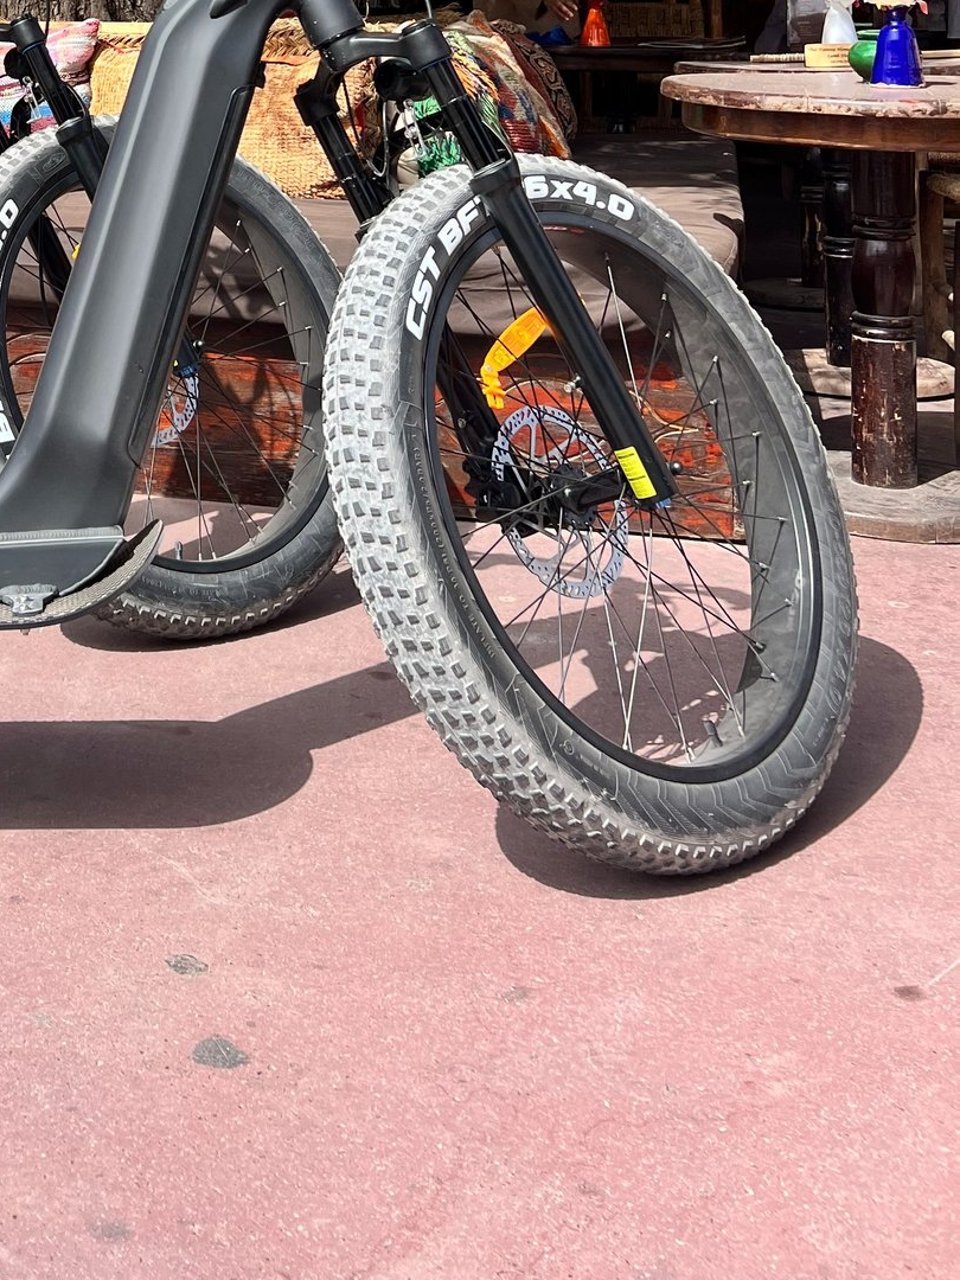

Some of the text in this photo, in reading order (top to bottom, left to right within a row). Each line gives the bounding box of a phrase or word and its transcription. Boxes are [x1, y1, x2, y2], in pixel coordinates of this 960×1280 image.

[522, 175, 635, 221] 6x4.0
[406, 195, 481, 341] CST BF
